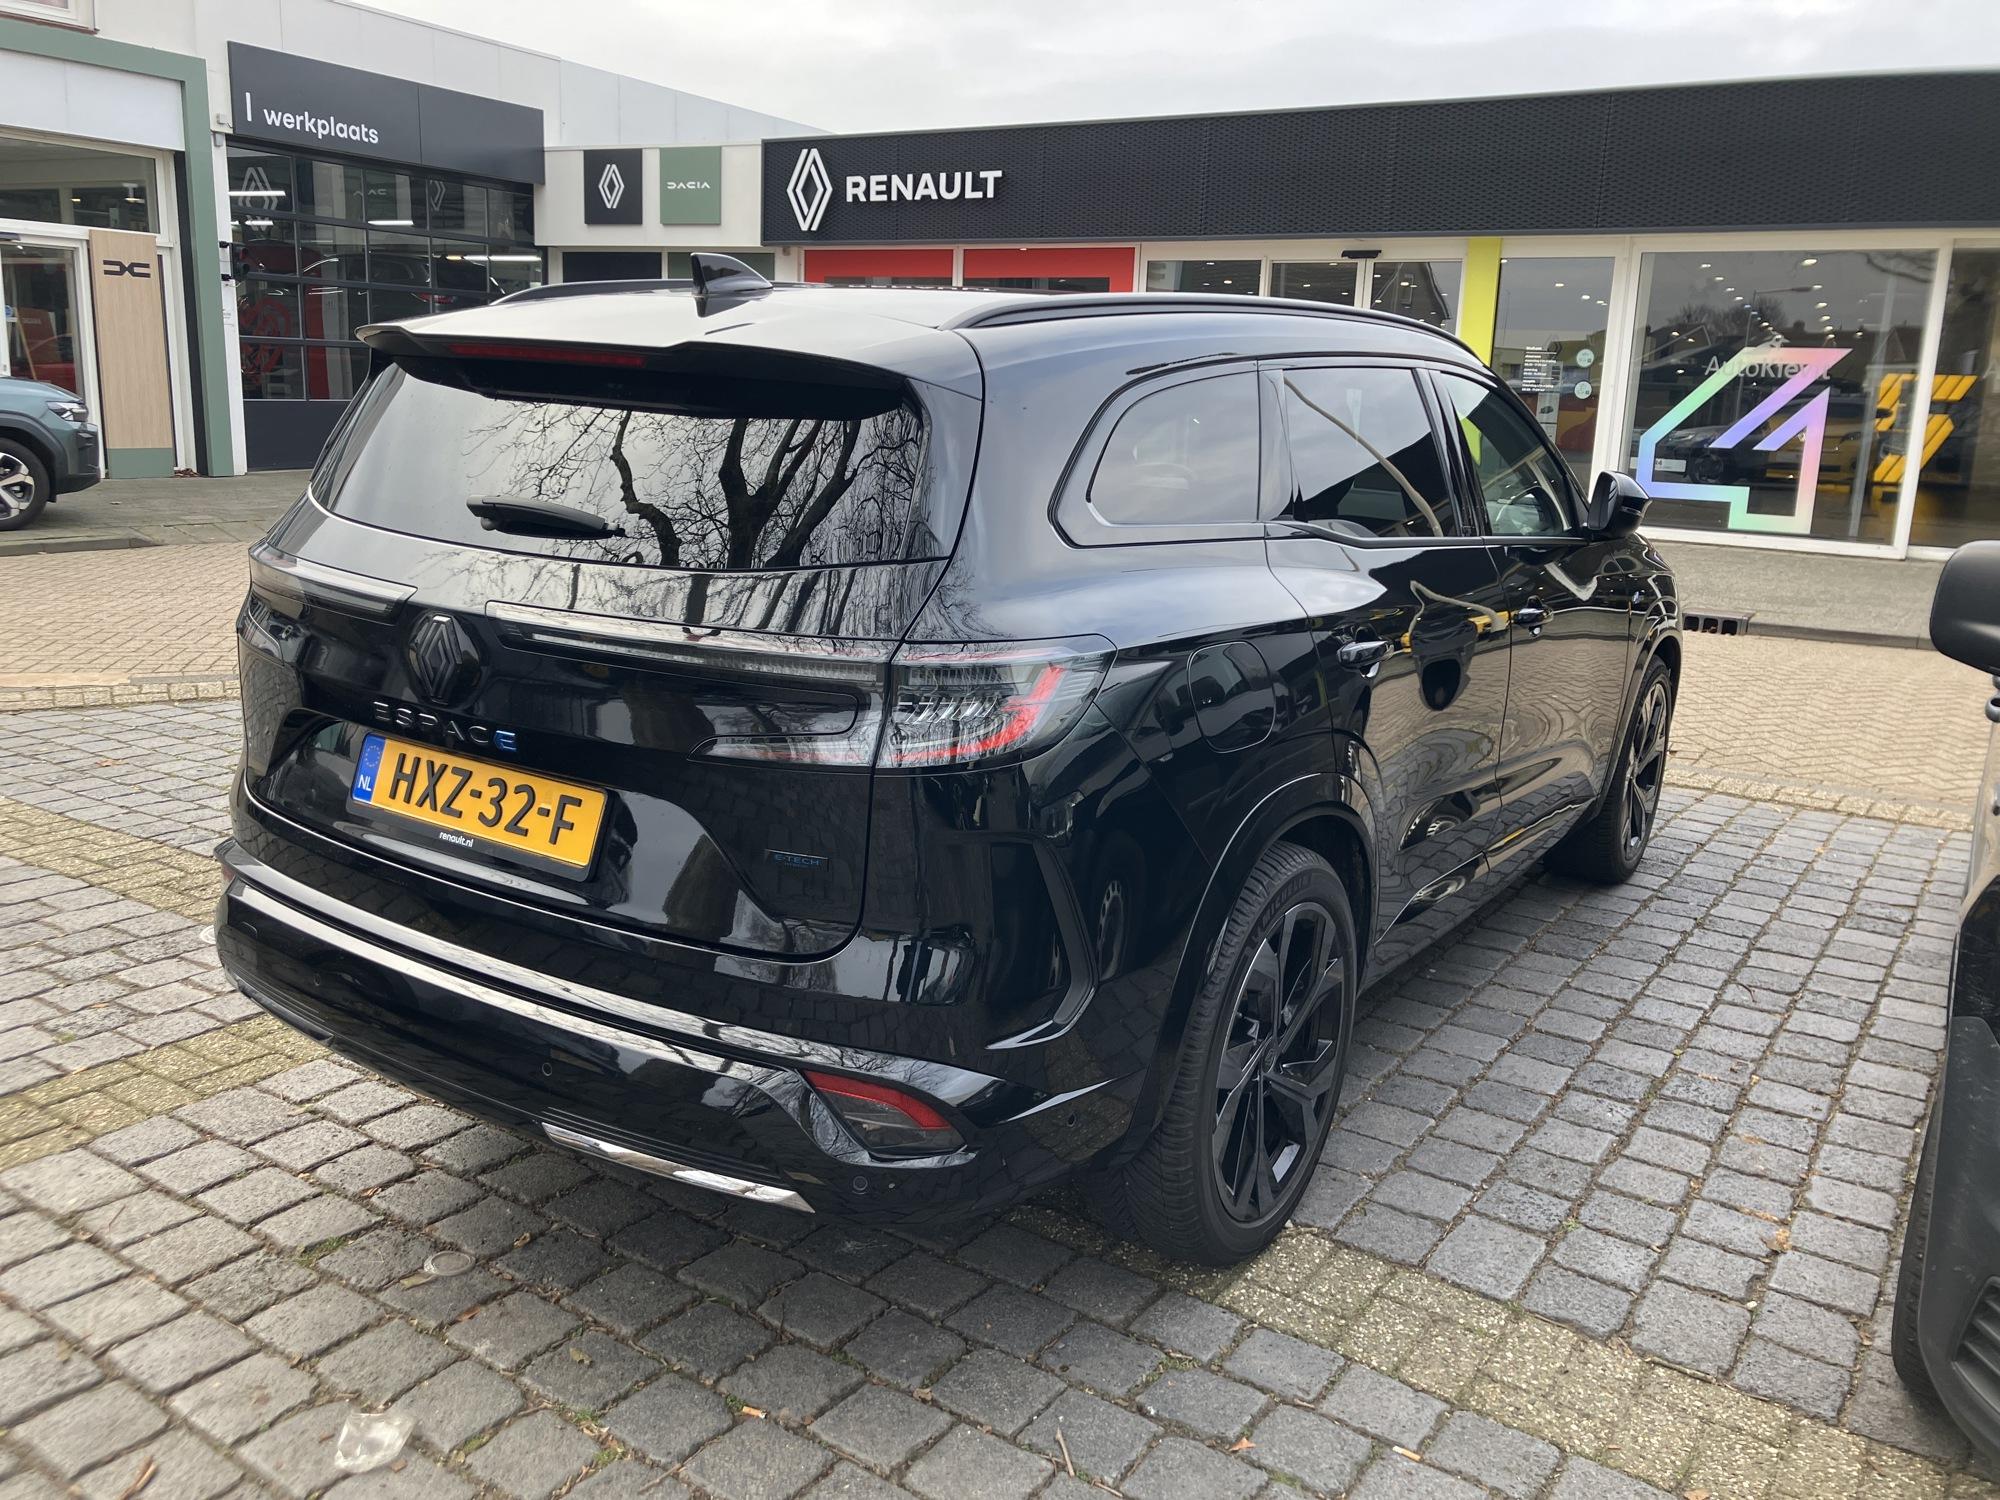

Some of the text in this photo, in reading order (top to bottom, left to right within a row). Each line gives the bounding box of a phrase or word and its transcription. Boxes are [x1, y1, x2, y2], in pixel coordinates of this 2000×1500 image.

[263, 108, 379, 144] werkplaats
[666, 181, 711, 190] DACIA
[845, 170, 1003, 202] RENAULT
[1704, 355, 1831, 380] AutoKievt
[373, 701, 517, 751] ESPACE
[357, 774, 372, 793] NL
[388, 752, 583, 846] HXZ-32-F
[439, 831, 474, 848] renault.nl
